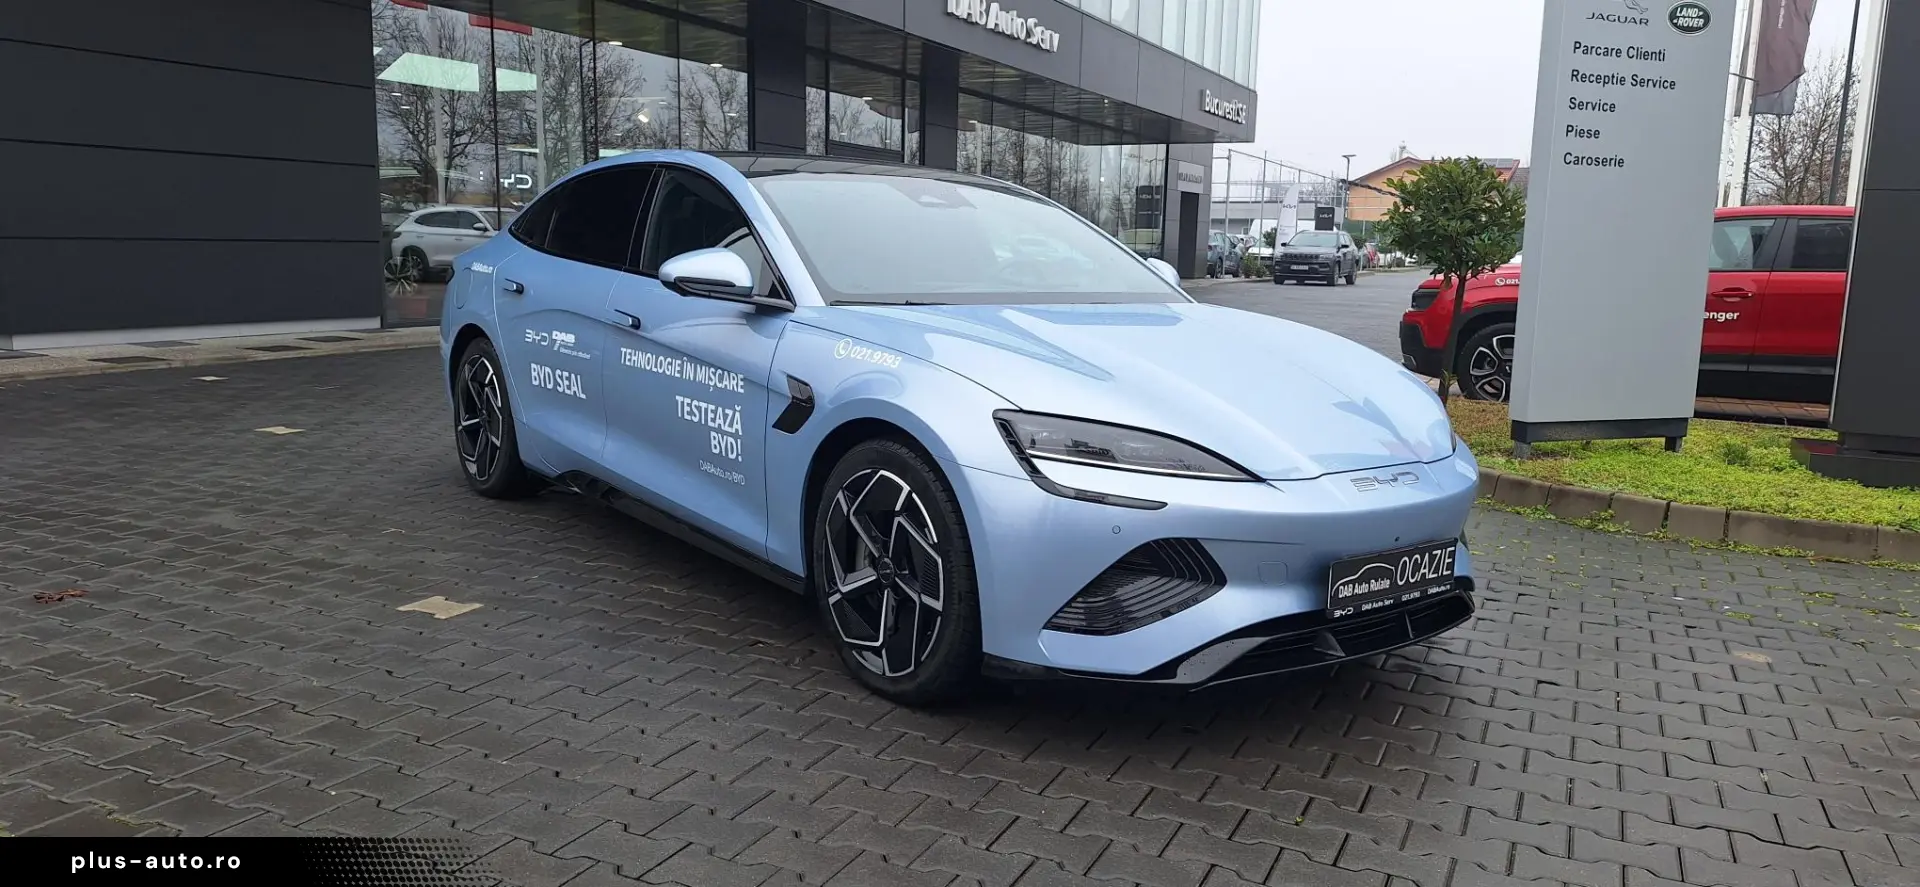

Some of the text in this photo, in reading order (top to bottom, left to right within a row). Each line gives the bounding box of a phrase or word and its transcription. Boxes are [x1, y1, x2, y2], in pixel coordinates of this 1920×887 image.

[1586, 12, 1649, 26] JAGUAR
[1676, 7, 1698, 17] LAND
[1677, 17, 1704, 28] ROVER
[946, 0, 1060, 53] DAB Auto Serv
[1573, 40, 1667, 62] Parcare Clienti
[1570, 68, 1676, 90] Receptie Service
[1568, 96, 1616, 113] Service
[1565, 124, 1601, 139] Piese
[1563, 151, 1625, 168] Caroserie
[1703, 311, 1740, 322] enger
[524, 328, 576, 346] BYD DAB
[850, 346, 902, 368] 021.9793
[530, 362, 587, 400] BYD SEAL
[620, 347, 682, 378] TEHNOLOGIE
[682, 356, 695, 381] ÎN
[696, 363, 745, 393] MIȘCARE
[675, 395, 743, 436] TESTEAZĂ
[710, 431, 743, 463] BYD!
[1350, 471, 1420, 493] BYD
[1396, 546, 1455, 586] OCAZIE
[1338, 577, 1391, 599] DAB Auto Rulate
[1333, 607, 1354, 618] BYD
